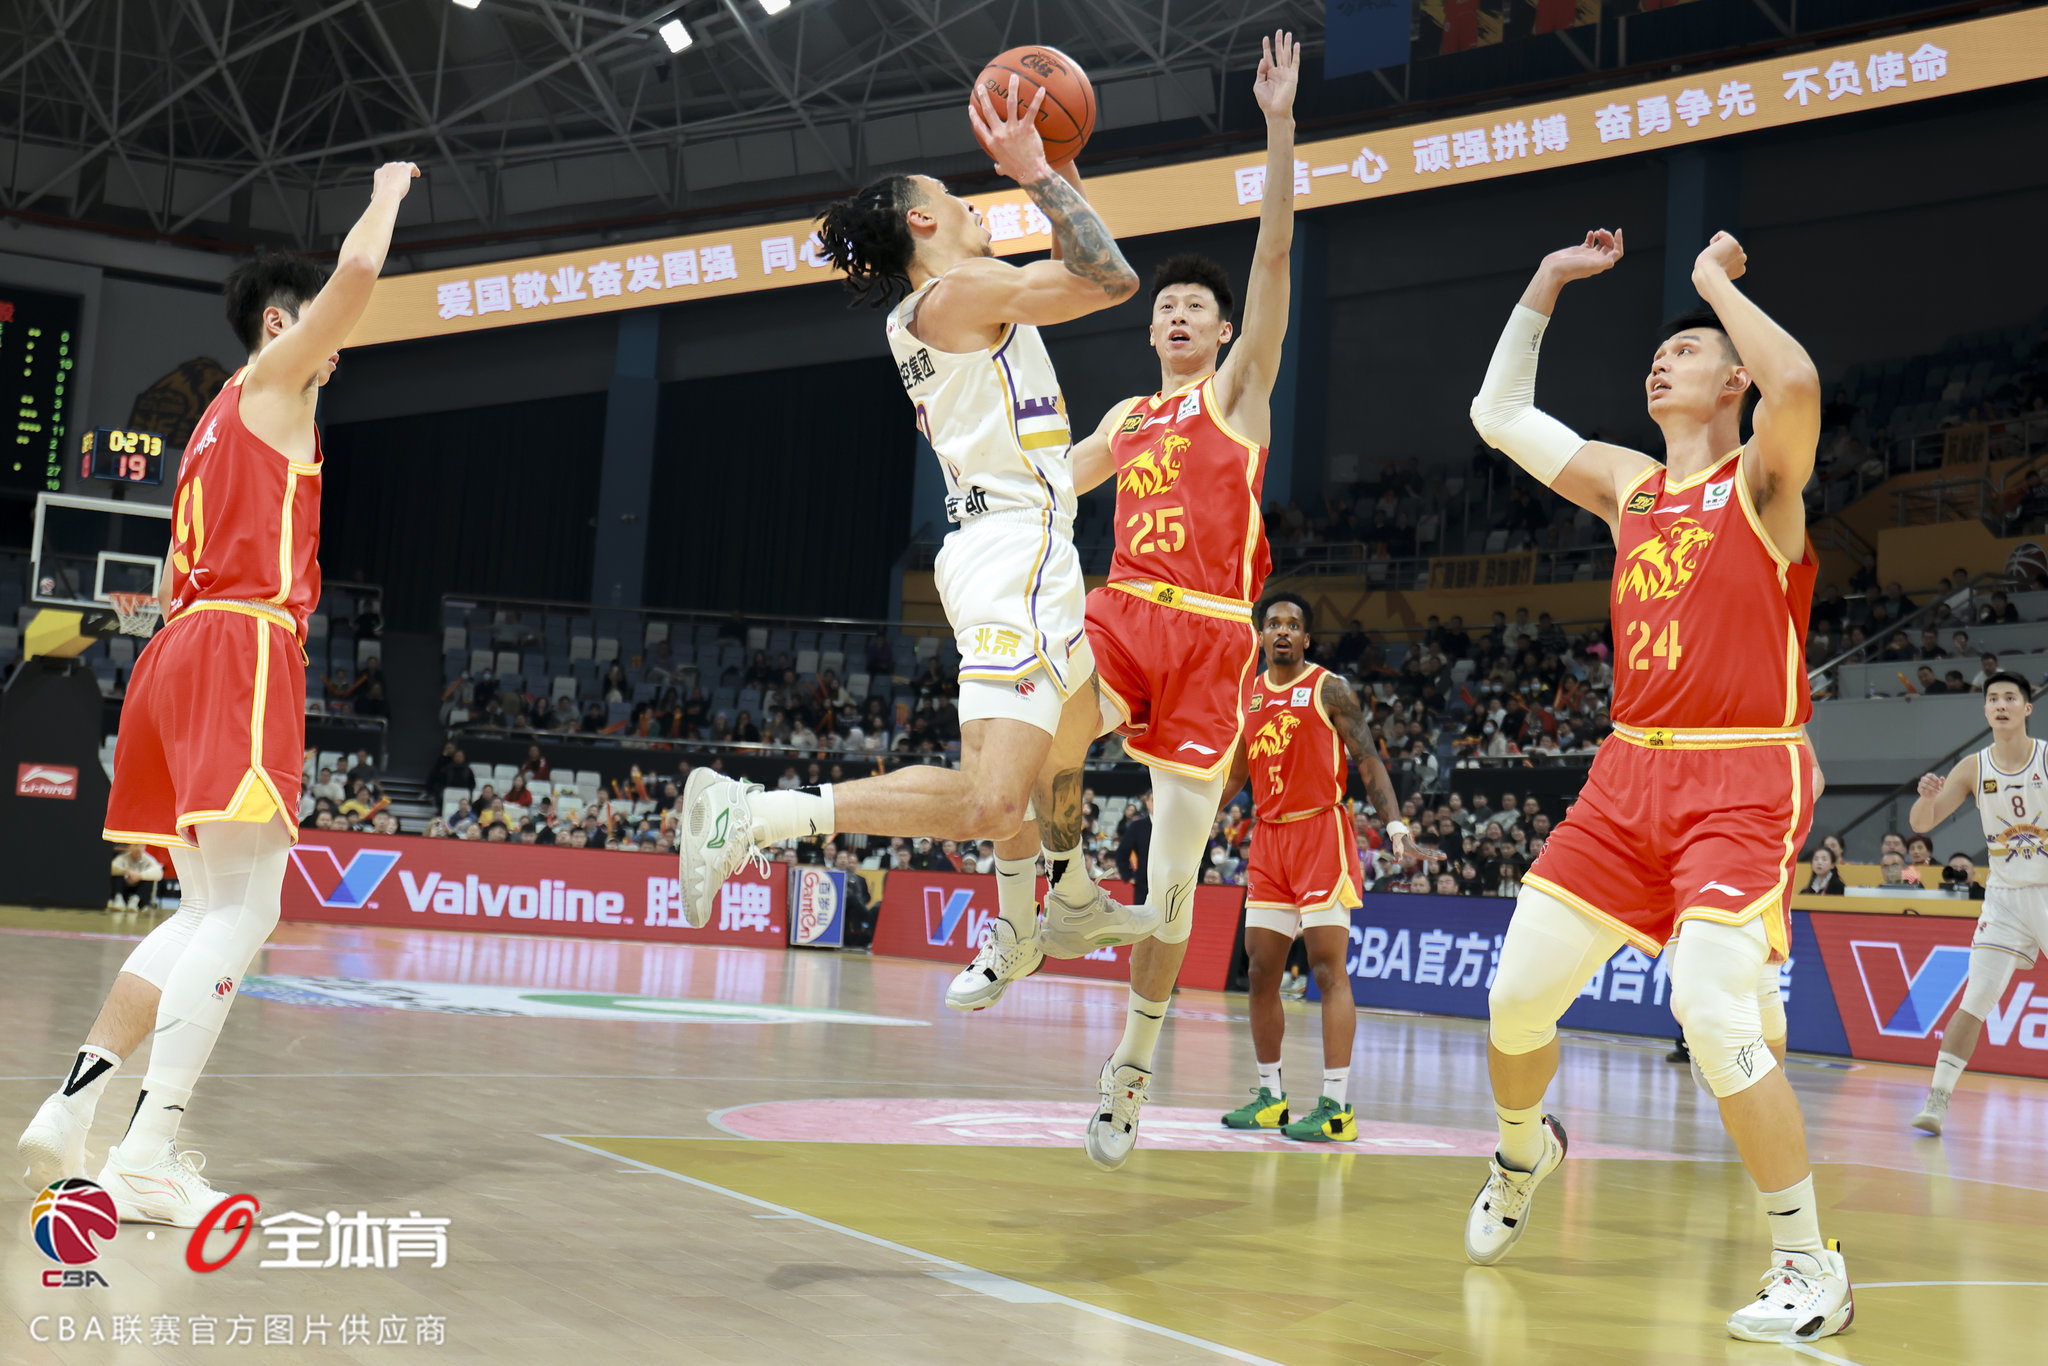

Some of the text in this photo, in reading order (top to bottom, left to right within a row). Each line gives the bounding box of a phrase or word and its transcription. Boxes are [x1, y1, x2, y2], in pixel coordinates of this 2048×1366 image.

[437, 244, 738, 320] 爱国敬业奋发图强
[1413, 114, 1571, 176] 顽强拼搏
[1594, 80, 1757, 145] 奋勇争先
[1782, 43, 1950, 108] 不负使命
[54, 397, 62, 409] 3
[52, 411, 61, 422] 4
[52, 424, 64, 437] 11
[50, 437, 58, 450] 2
[48, 450, 57, 463] 2
[119, 454, 147, 481] 19
[46, 464, 61, 477] 27
[1126, 507, 1186, 557] 25
[974, 627, 1022, 657] 北京
[1626, 620, 1682, 671] 24
[20, 783, 73, 796] LI-NING
[1268, 765, 1284, 796] 5
[2011, 795, 2026, 818] 8
[398, 871, 625, 924] Valvoline
